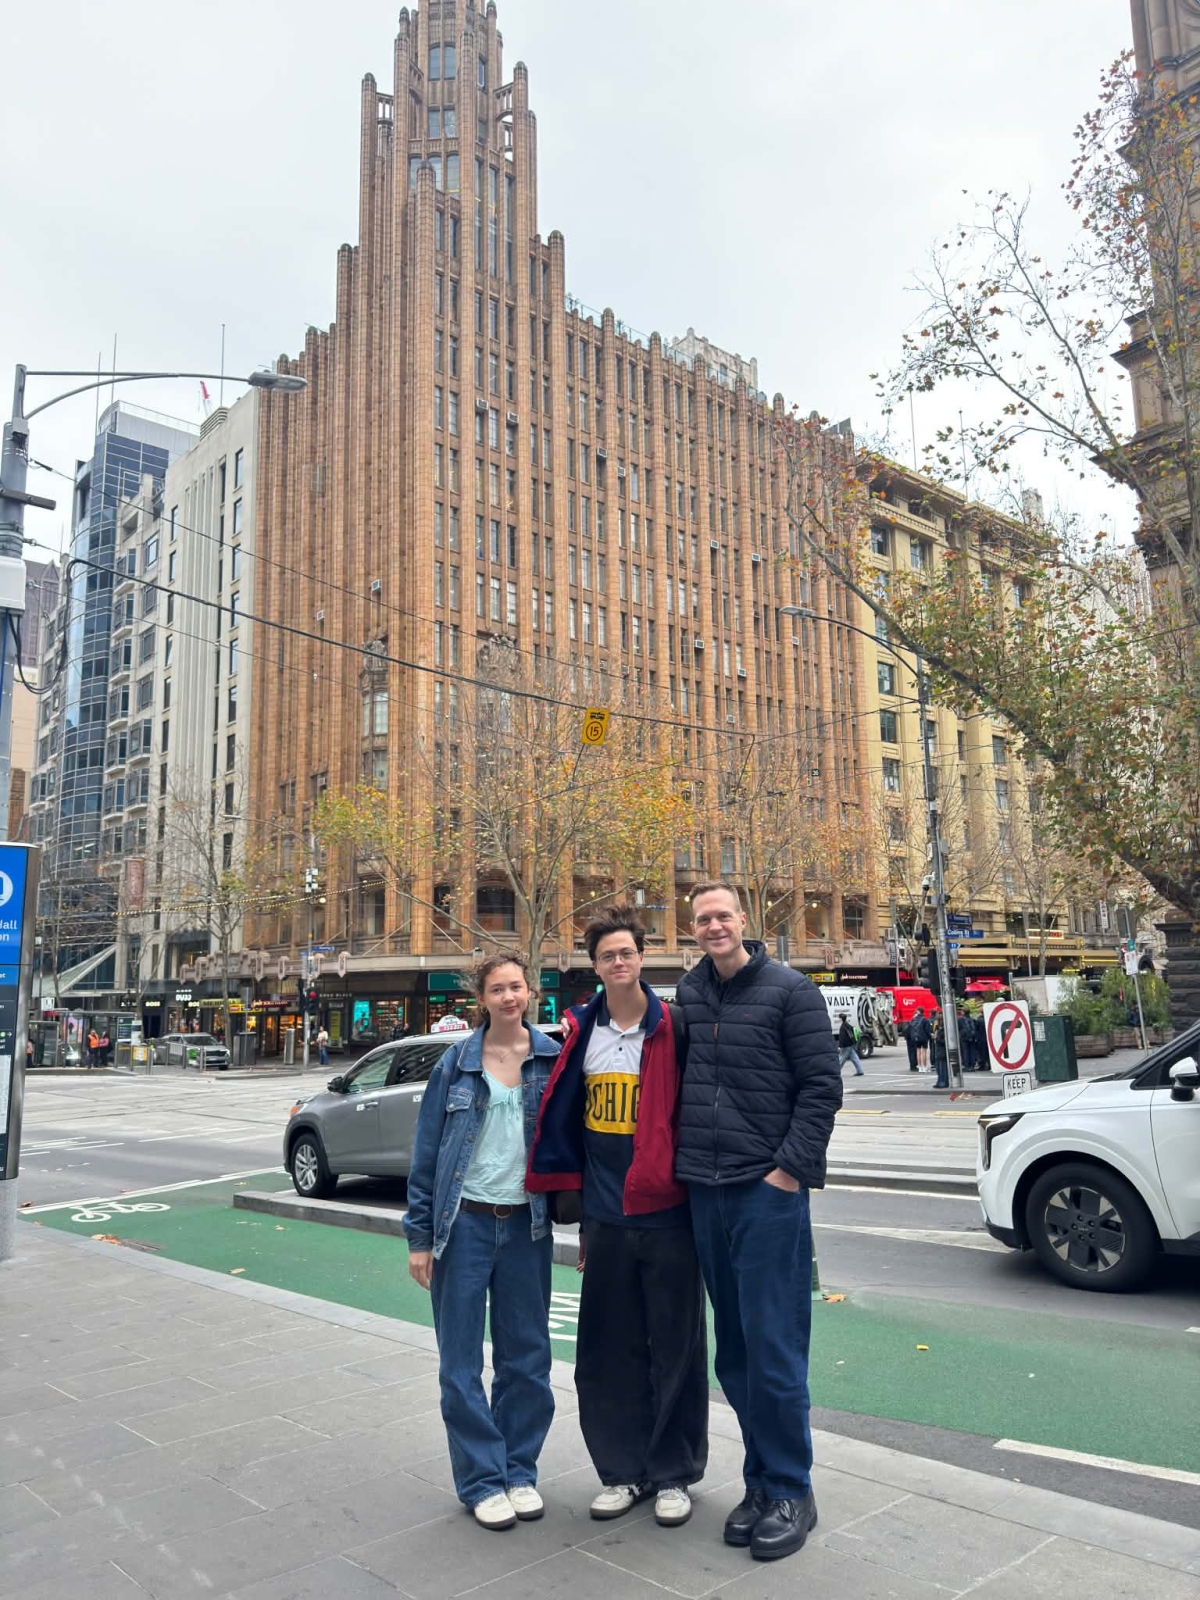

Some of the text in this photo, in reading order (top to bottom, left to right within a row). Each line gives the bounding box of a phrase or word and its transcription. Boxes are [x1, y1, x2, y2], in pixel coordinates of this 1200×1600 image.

[590, 726, 599, 737] 15
[827, 996, 854, 1006] VAULT
[1007, 1078, 1026, 1090] KEEP
